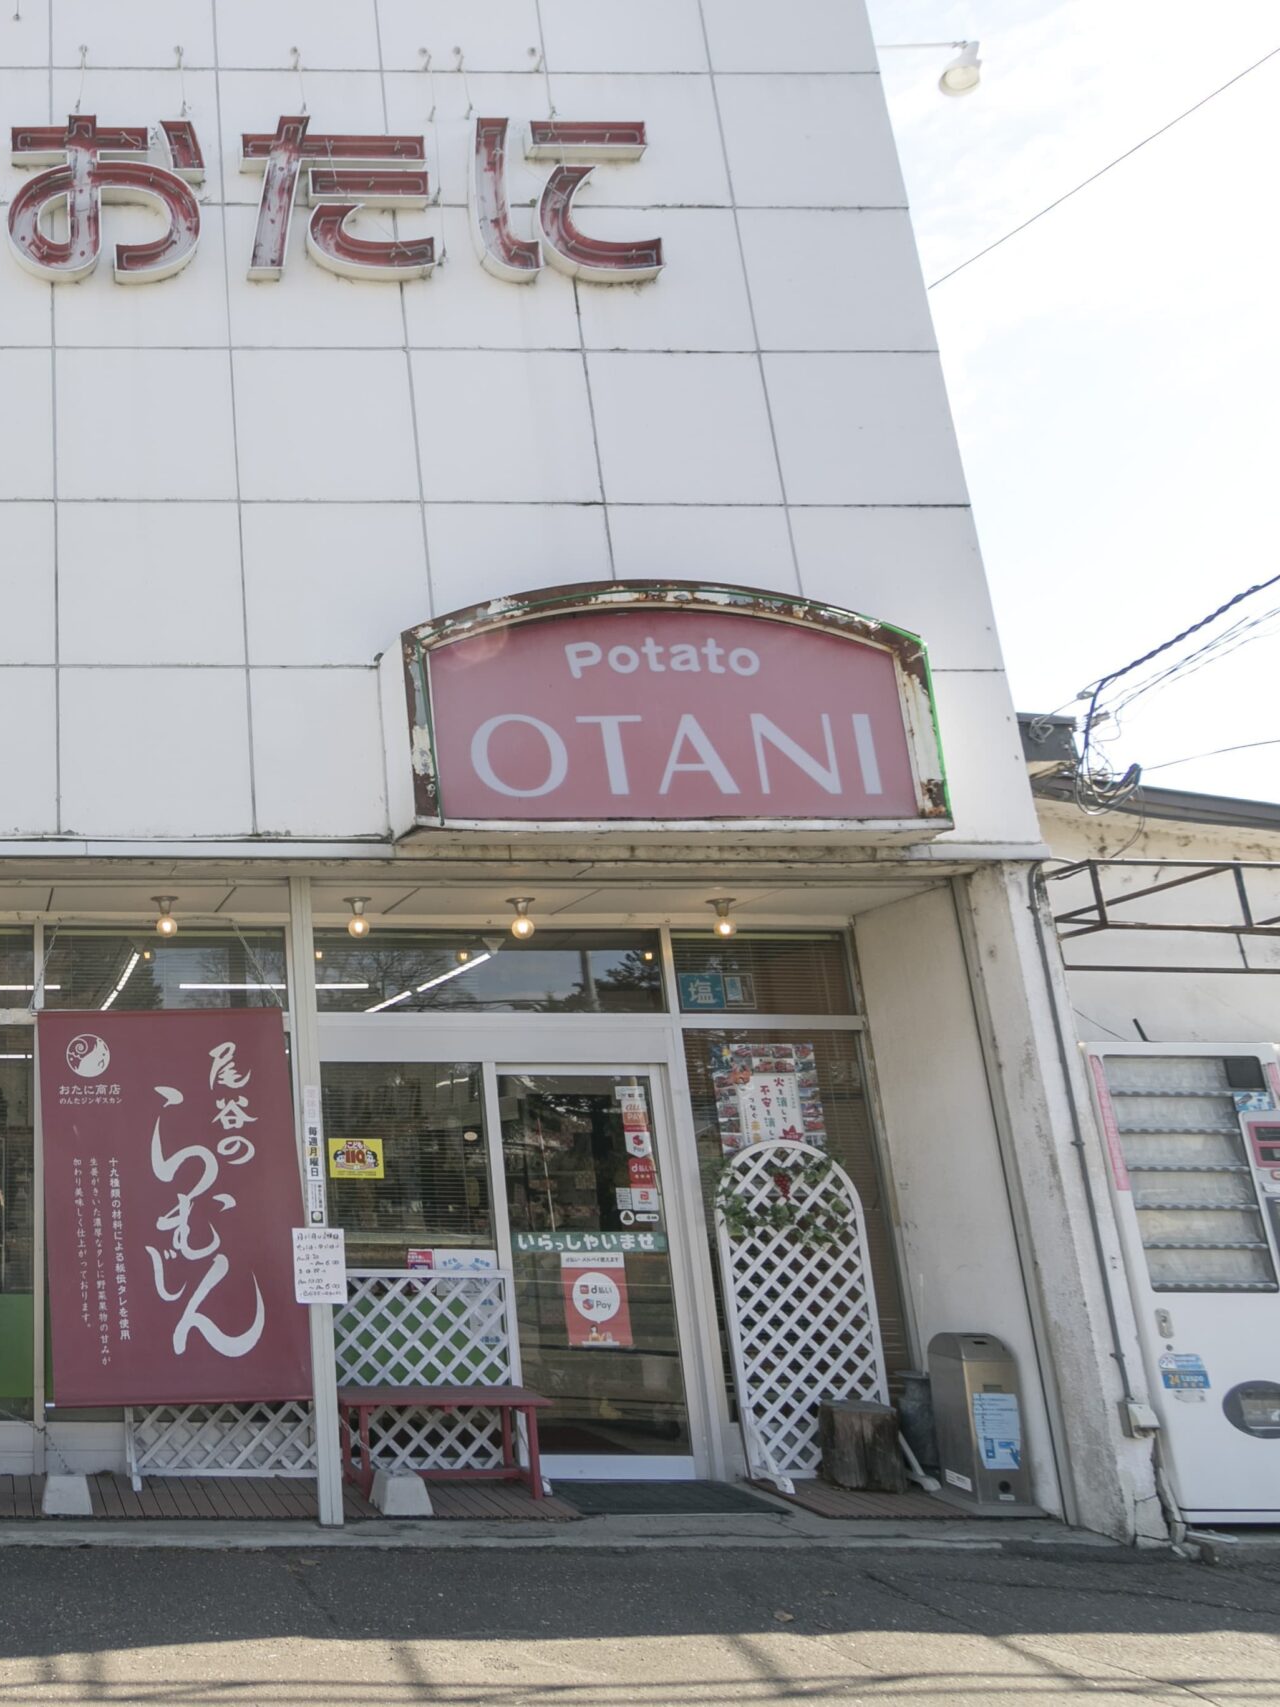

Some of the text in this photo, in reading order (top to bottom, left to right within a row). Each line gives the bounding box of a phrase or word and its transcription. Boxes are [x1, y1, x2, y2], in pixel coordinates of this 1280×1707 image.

[8, 114, 664, 284] おたに
[564, 637, 760, 678] Potato
[470, 713, 883, 798] OTANI
[59, 1085, 120, 1096] おたに商店
[209, 1041, 258, 1165] 尾谷の
[308, 1126, 320, 1177] 毎週月曜日
[145, 1086, 265, 1357] らむじん
[591, 1284, 613, 1294] d払い
[596, 1301, 612, 1311] Pay
